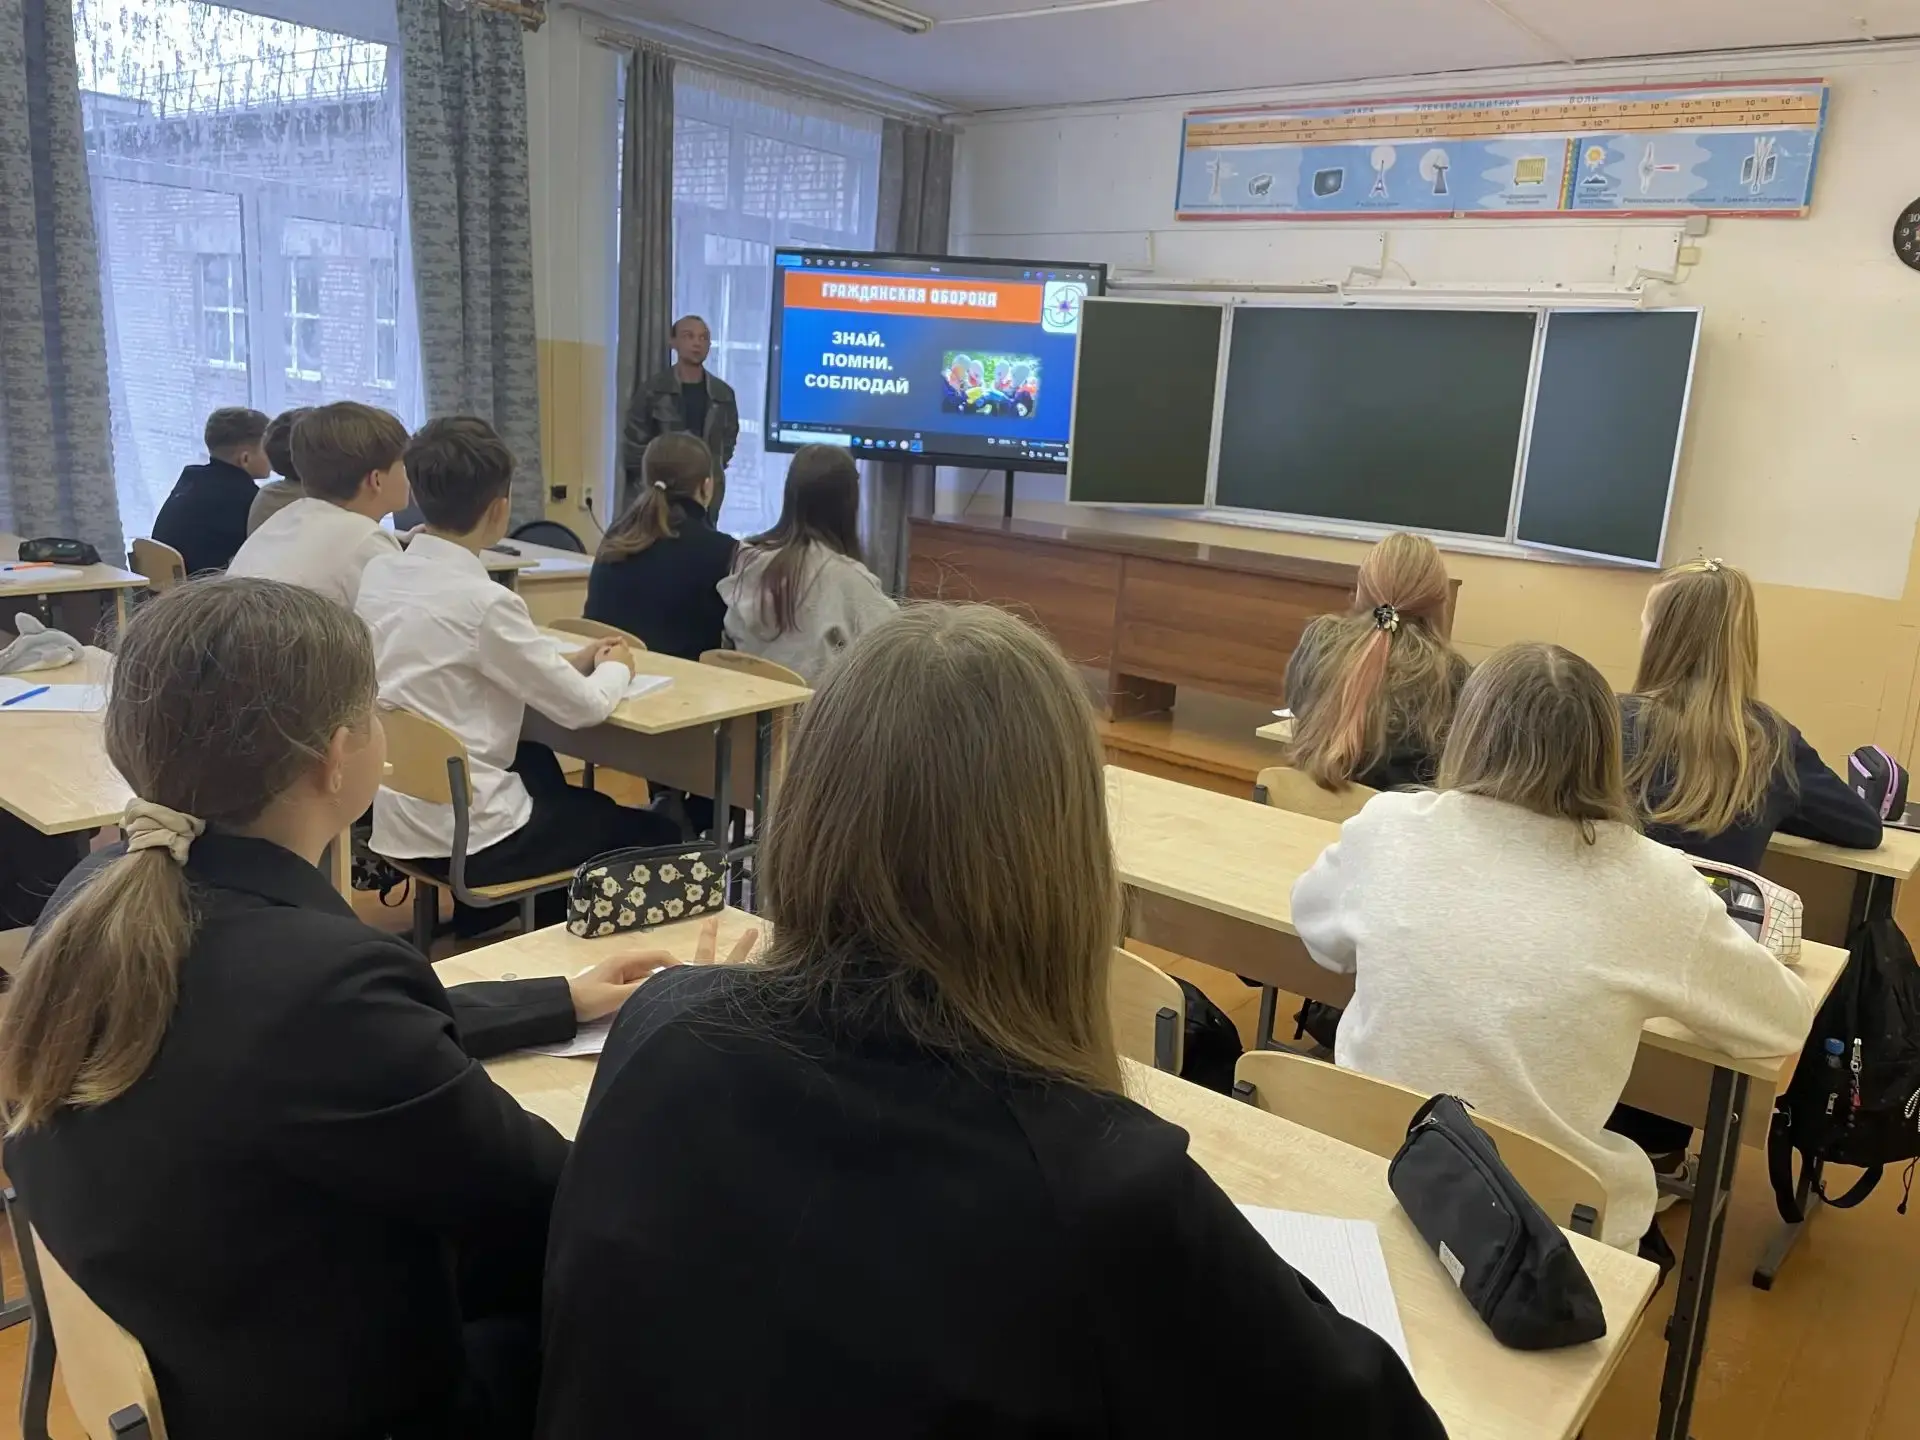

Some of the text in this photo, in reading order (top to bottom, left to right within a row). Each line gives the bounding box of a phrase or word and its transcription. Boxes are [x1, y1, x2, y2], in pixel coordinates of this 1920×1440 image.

[1414, 98, 1520, 111] ЭЛЕКТРОМАГНИТНЫХ
[1568, 95, 1600, 104] ВОЛН
[1902, 228, 1910, 236] 9
[1903, 241, 1911, 251] 8
[822, 282, 998, 308] ГРАЖДАНСКАЯ ОБОРОНА
[832, 330, 885, 348] ЗНАЙ.
[822, 352, 893, 371] ПОМНИ.
[804, 372, 910, 395] СОБЛЮДАЙ
